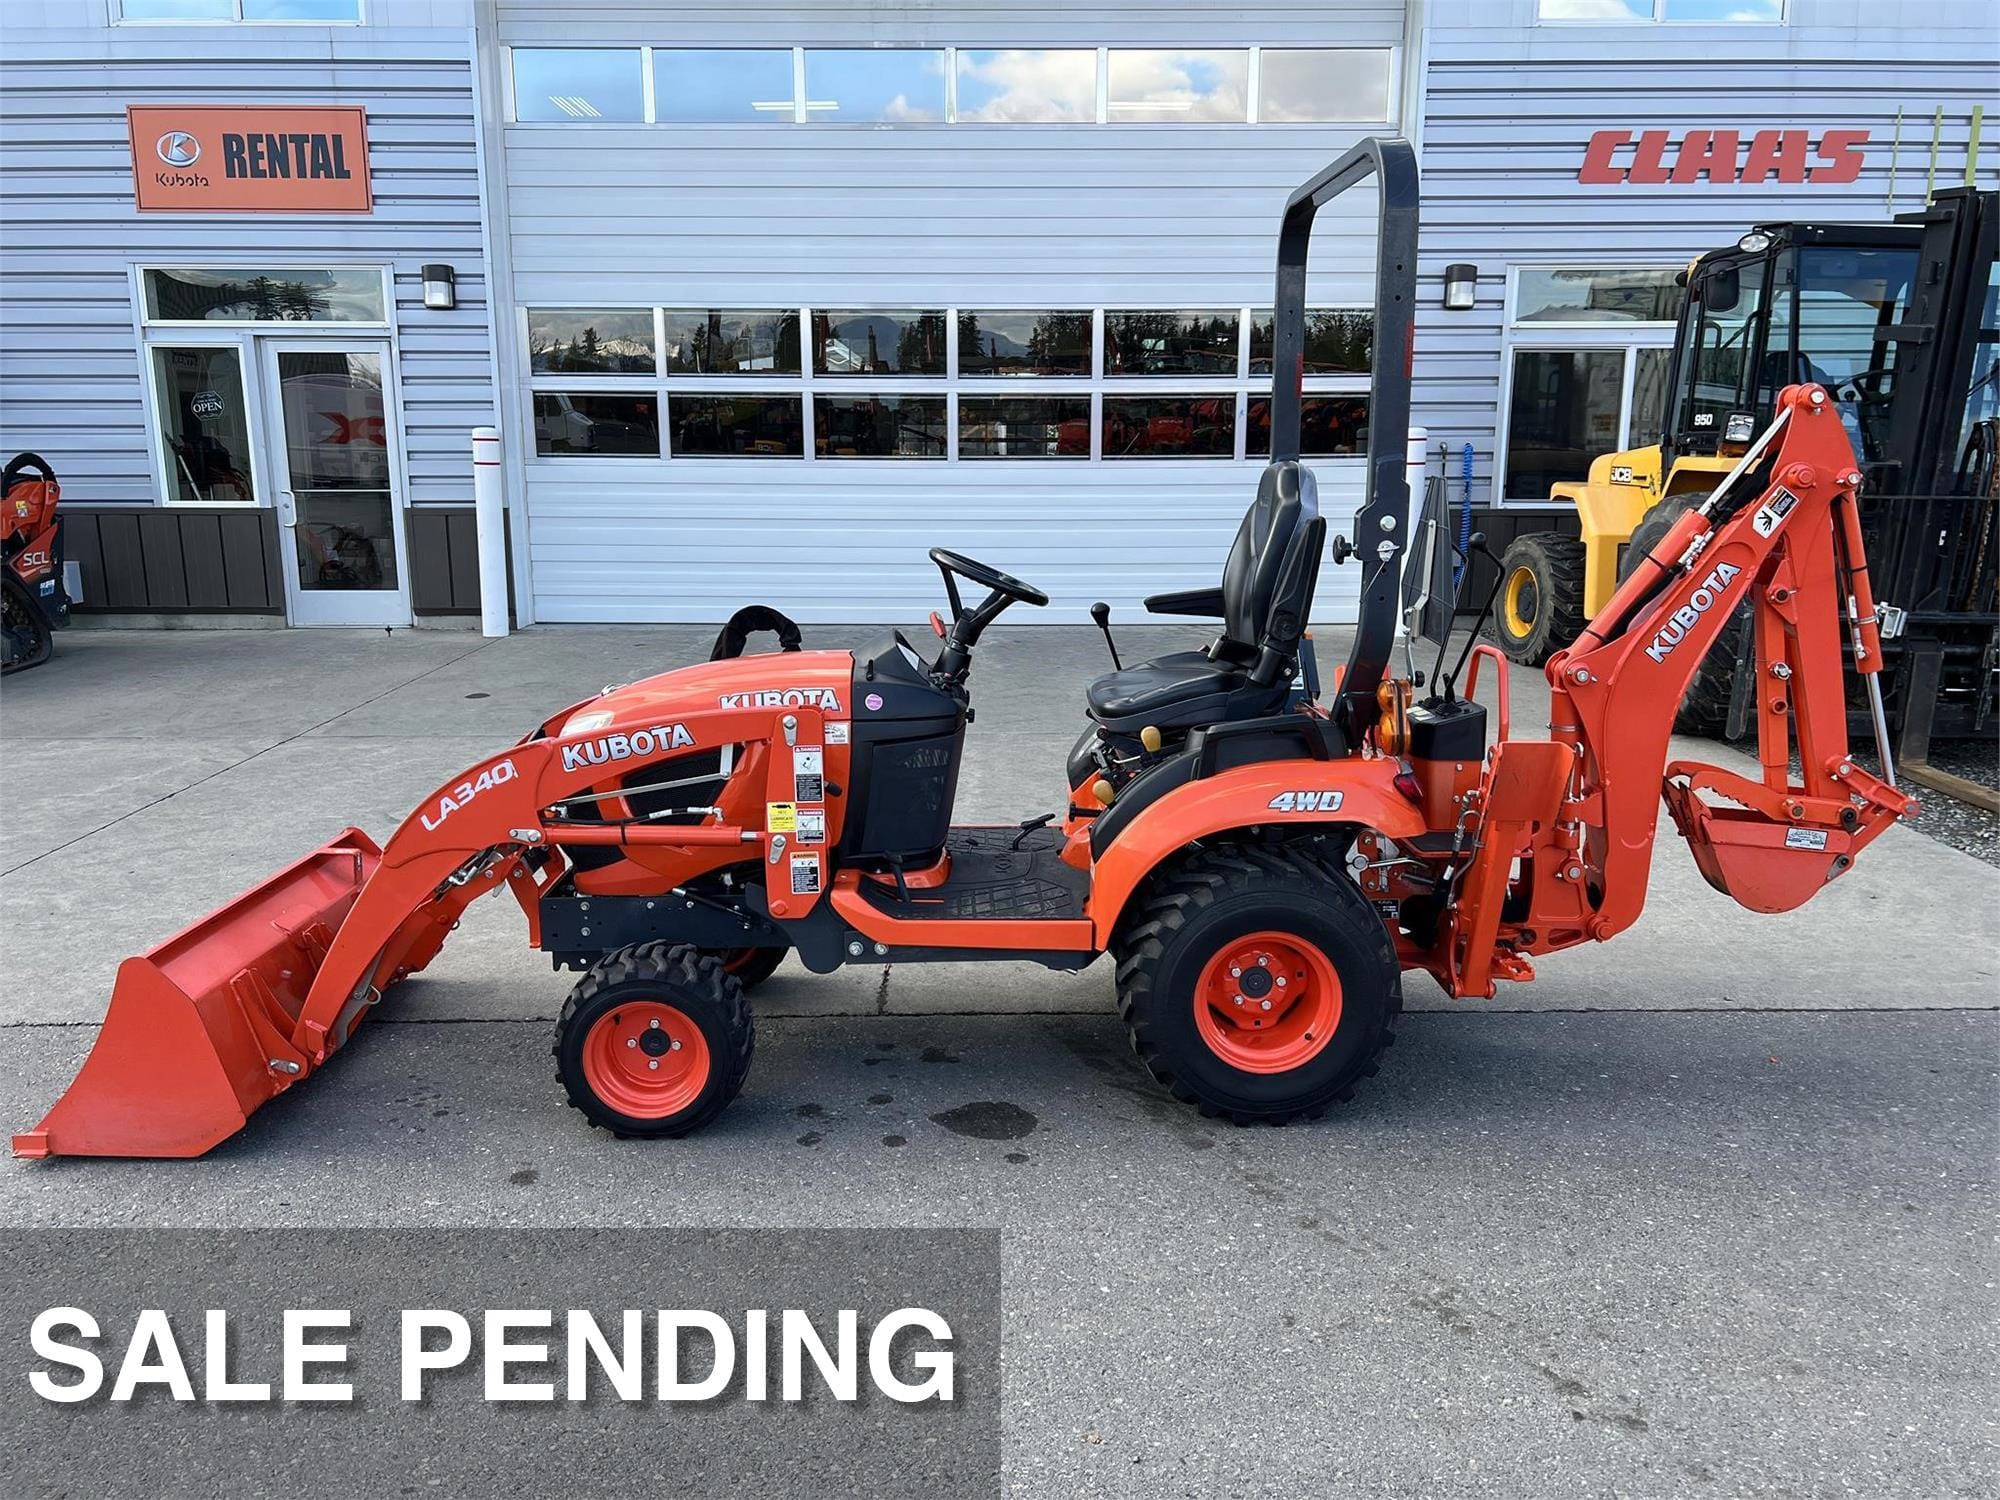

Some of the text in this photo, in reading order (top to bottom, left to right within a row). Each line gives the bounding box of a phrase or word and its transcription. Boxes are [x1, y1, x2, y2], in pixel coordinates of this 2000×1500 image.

[222, 132, 351, 179] RENTAL
[1578, 129, 1871, 184] CLAAS
[155, 172, 209, 187] Kubota
[192, 401, 223, 413] OPEN
[1694, 413, 1713, 426] 950
[1611, 467, 1632, 482] JCB
[23, 551, 49, 567] SCL
[1644, 562, 1742, 664] KUBOTA
[561, 723, 696, 769] KUBOTA
[420, 759, 515, 832] LA340
[1267, 790, 1344, 812] 4WD
